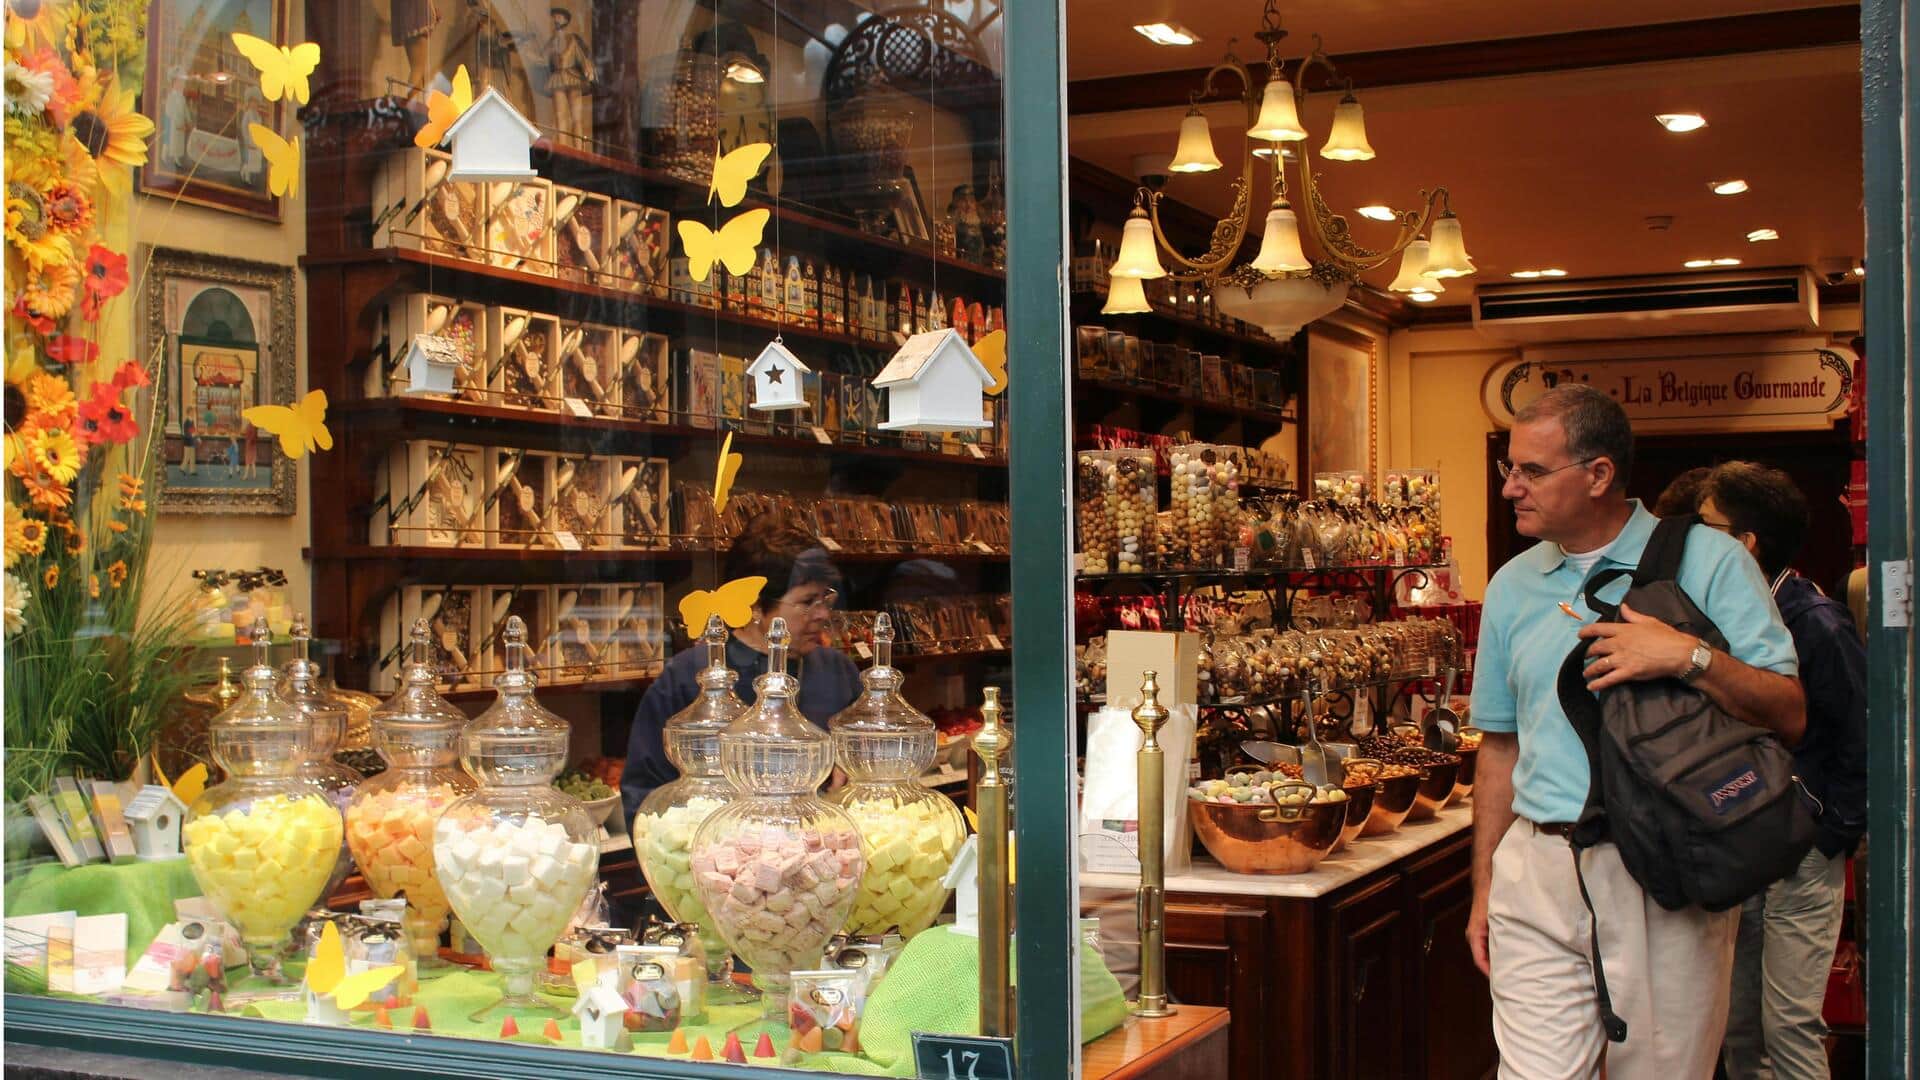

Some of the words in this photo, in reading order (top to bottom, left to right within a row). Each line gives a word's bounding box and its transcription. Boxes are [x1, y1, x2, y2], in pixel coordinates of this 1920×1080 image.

[1623, 376, 1651, 404] La
[1659, 370, 1728, 407] Belgique
[1734, 369, 1826, 402] Gourmande
[942, 1048, 980, 1080] 17
